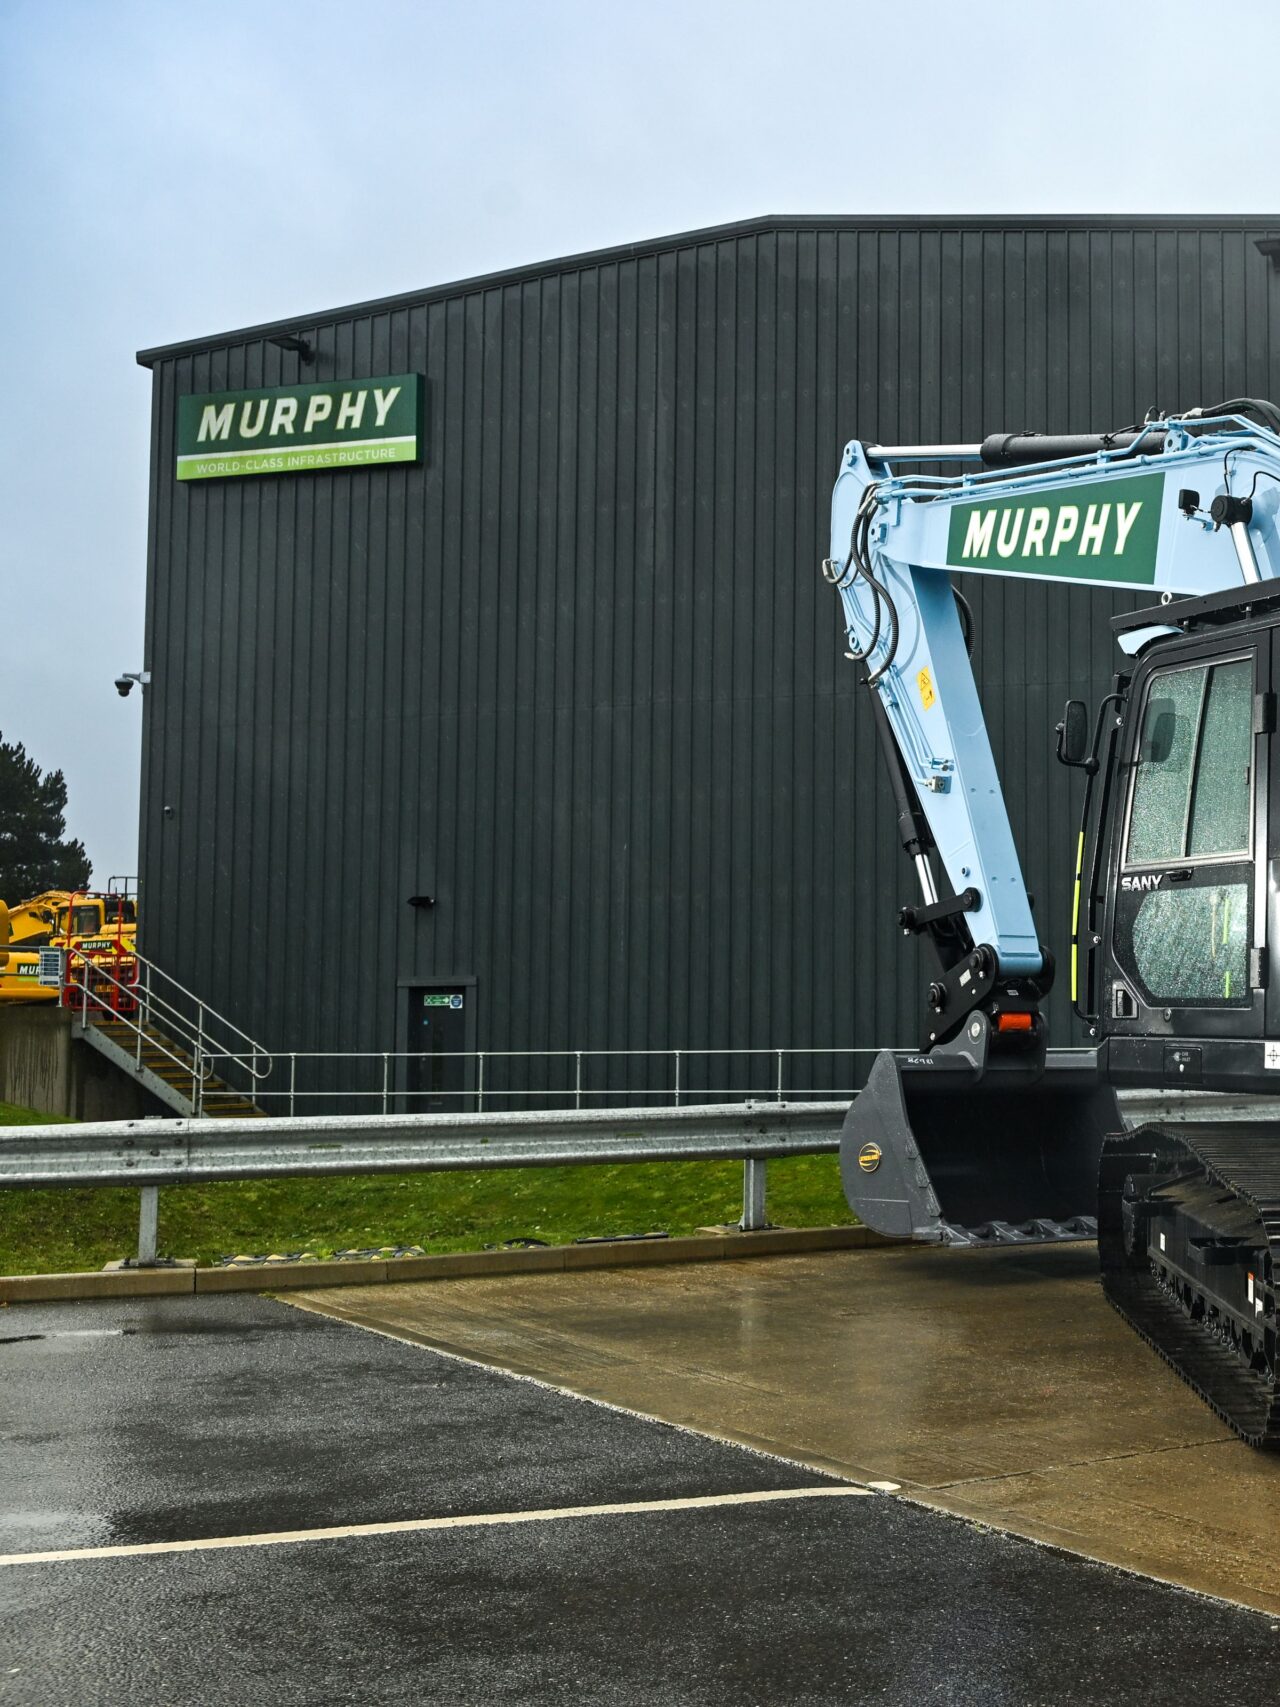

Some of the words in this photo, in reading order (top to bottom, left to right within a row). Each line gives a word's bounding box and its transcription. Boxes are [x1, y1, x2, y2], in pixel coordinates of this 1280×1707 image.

[197, 386, 401, 442] MURPHY
[197, 457, 283, 474] WORLD-CLASS
[288, 447, 396, 467] INFRASTRUCTURE
[962, 502, 1143, 559] MURPHY
[1121, 875, 1162, 891] SANY
[82, 941, 111, 950] MURPHY
[20, 965, 41, 975] MUR
